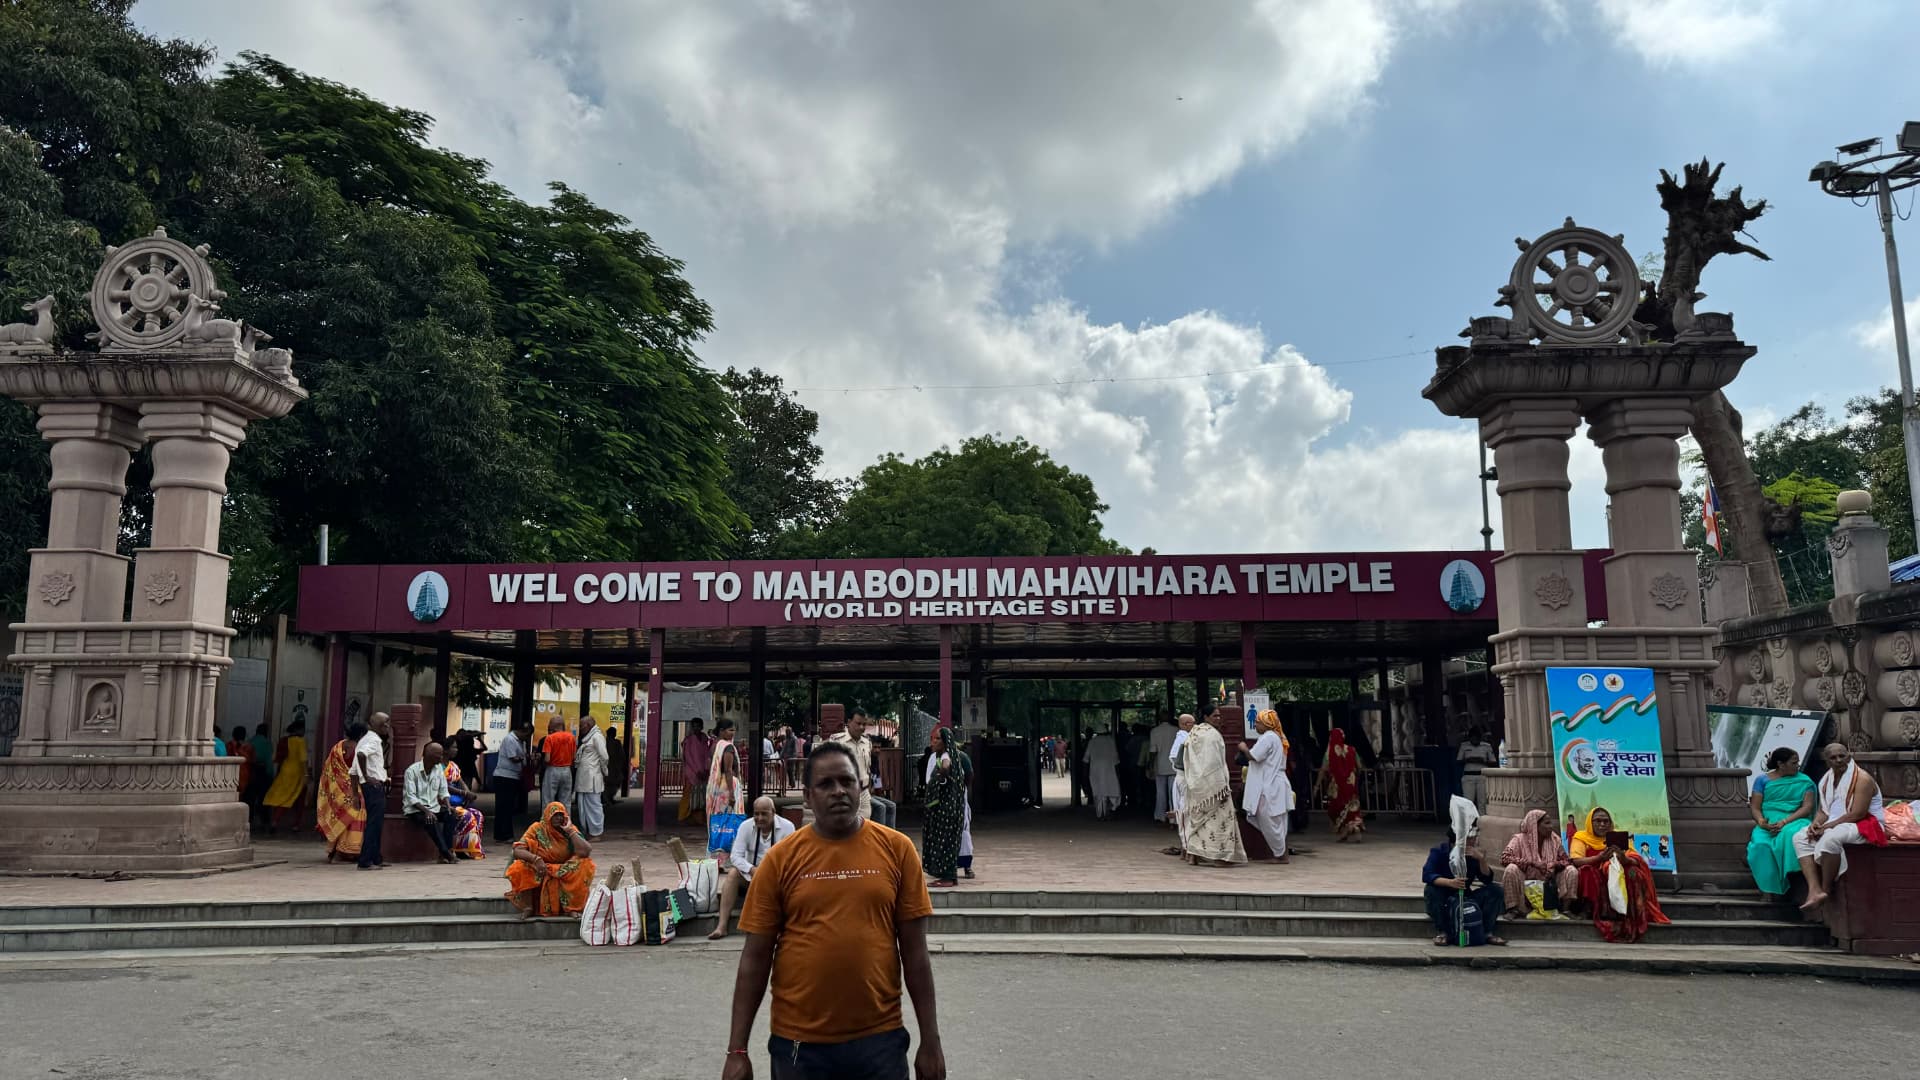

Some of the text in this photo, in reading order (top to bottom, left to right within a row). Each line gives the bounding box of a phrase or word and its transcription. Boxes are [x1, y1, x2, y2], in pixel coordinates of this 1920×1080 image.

[692, 571, 741, 602] TO
[753, 568, 978, 600] MAHABODHI
[986, 564, 1237, 597] MAHAVIHARA
[1239, 562, 1395, 594] TEMPLE
[909, 599, 1045, 617] HERITAGE
[1597, 752, 1656, 763] स्वच्छता
[1600, 761, 1656, 776] ही सेवा
